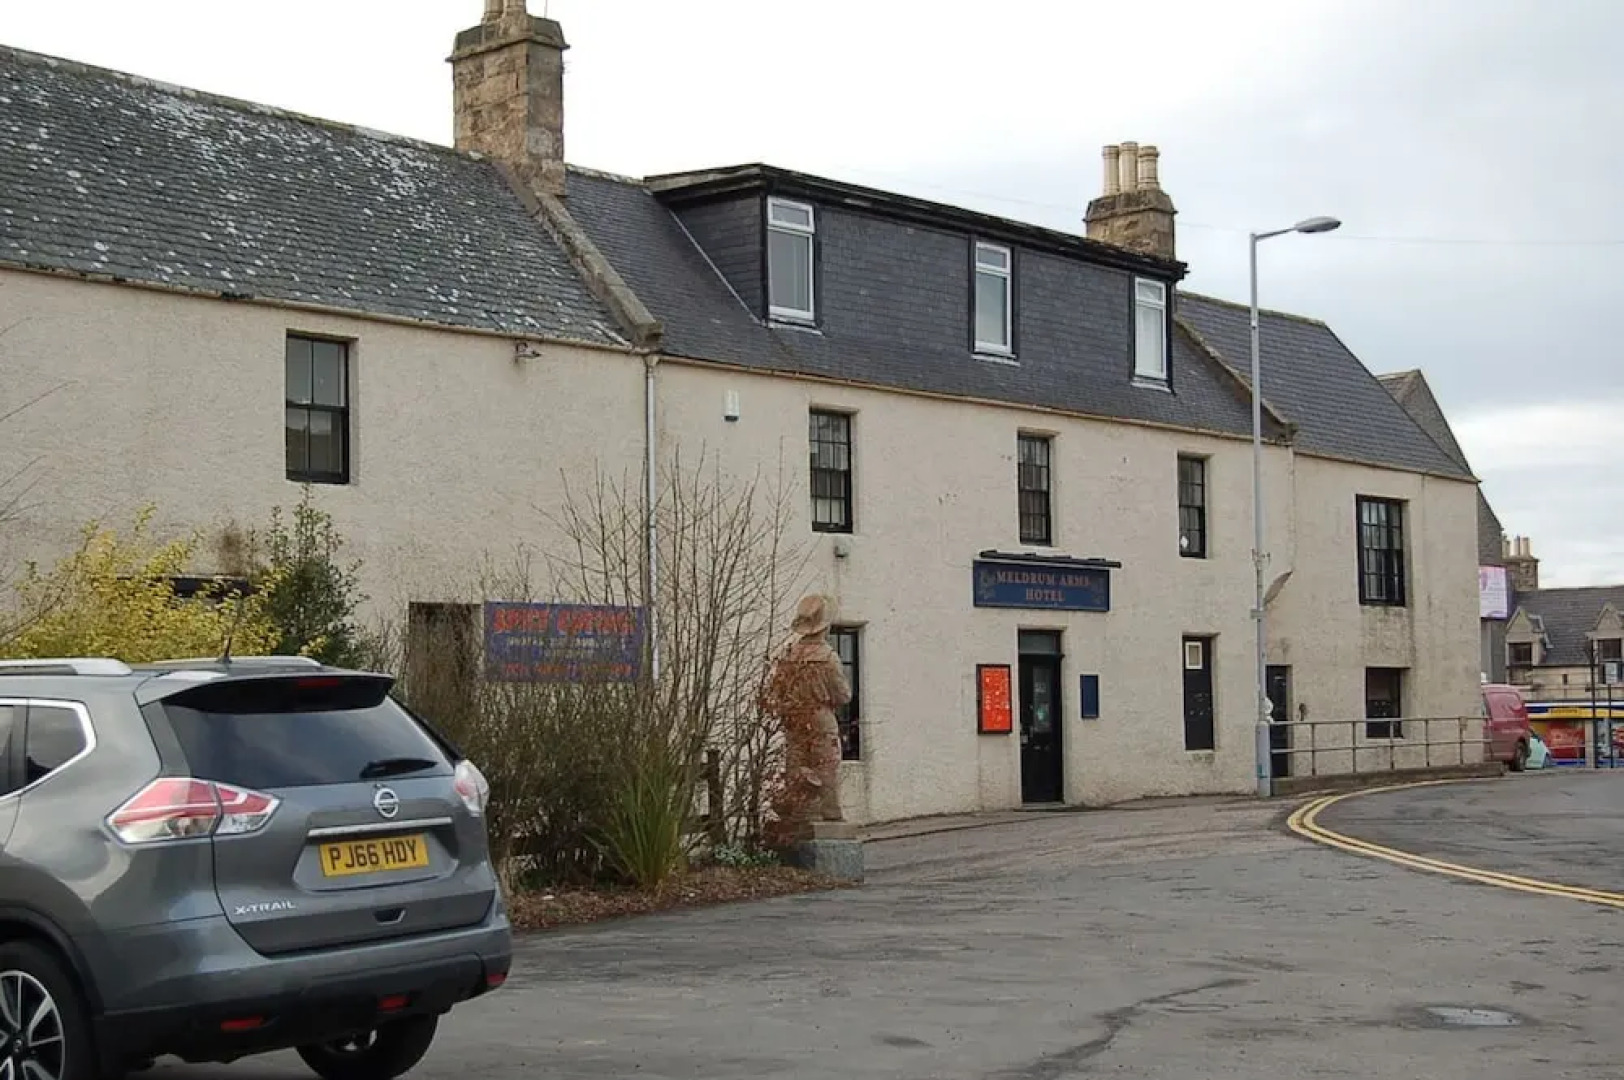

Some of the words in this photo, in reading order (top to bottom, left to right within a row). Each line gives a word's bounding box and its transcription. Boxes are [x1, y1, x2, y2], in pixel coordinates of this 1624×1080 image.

[996, 571, 1055, 586] MELDRUM
[1025, 588, 1066, 602] HOTEL
[329, 841, 381, 871] PJ66
[383, 839, 418, 865] HDY
[234, 900, 297, 915] X-TRAIL
